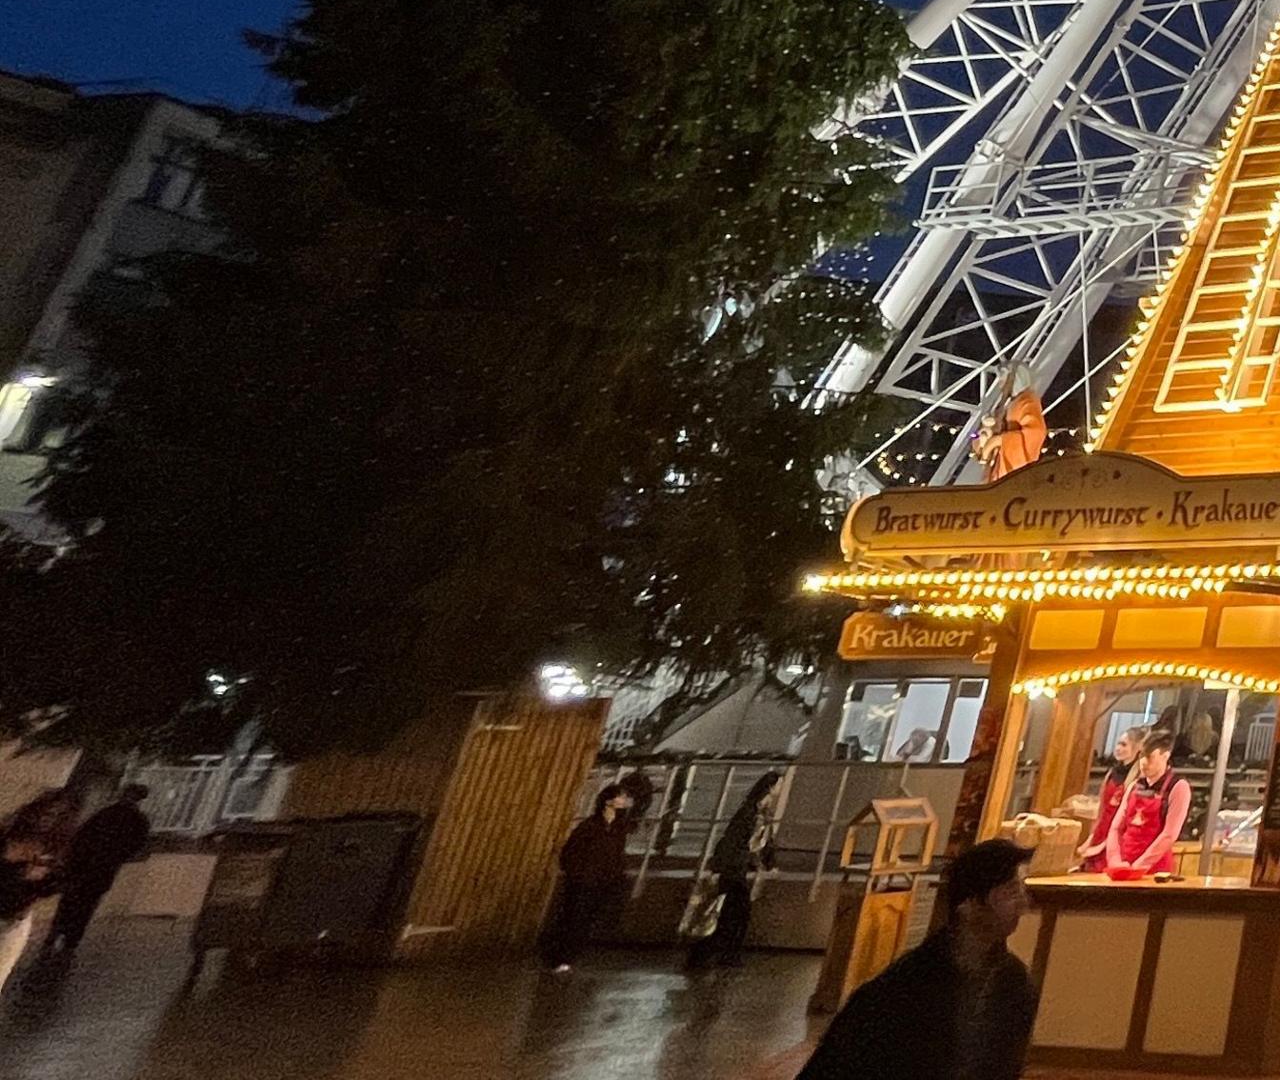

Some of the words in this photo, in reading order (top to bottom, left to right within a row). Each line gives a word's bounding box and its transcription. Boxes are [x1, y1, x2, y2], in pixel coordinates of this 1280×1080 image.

[872, 505, 985, 534] Bratwurst
[1003, 496, 1151, 537] Currywurst
[849, 623, 975, 651] Krakauer
